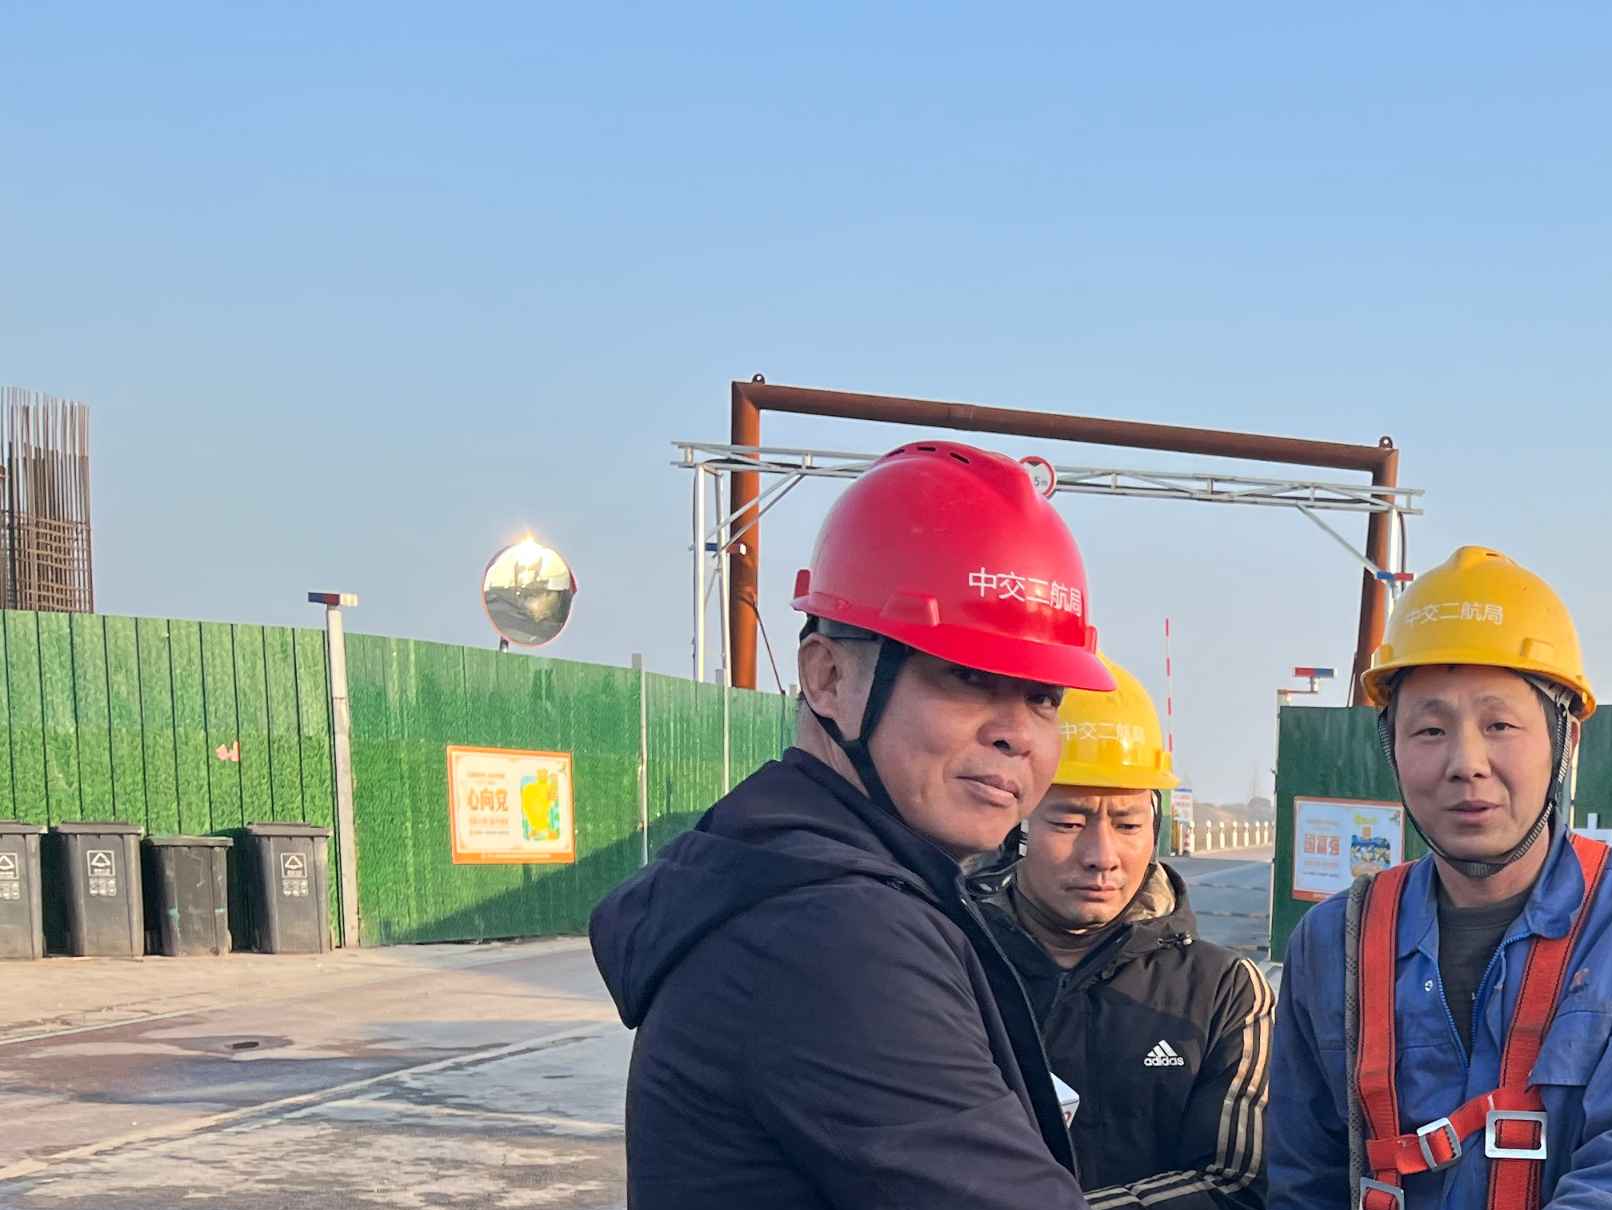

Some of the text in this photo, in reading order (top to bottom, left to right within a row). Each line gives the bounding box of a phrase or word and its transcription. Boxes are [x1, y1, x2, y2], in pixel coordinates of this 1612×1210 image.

[968, 567, 1083, 617] 中交二航局
[1406, 600, 1504, 627] 中交二航局
[1143, 1056, 1185, 1067] adidas
